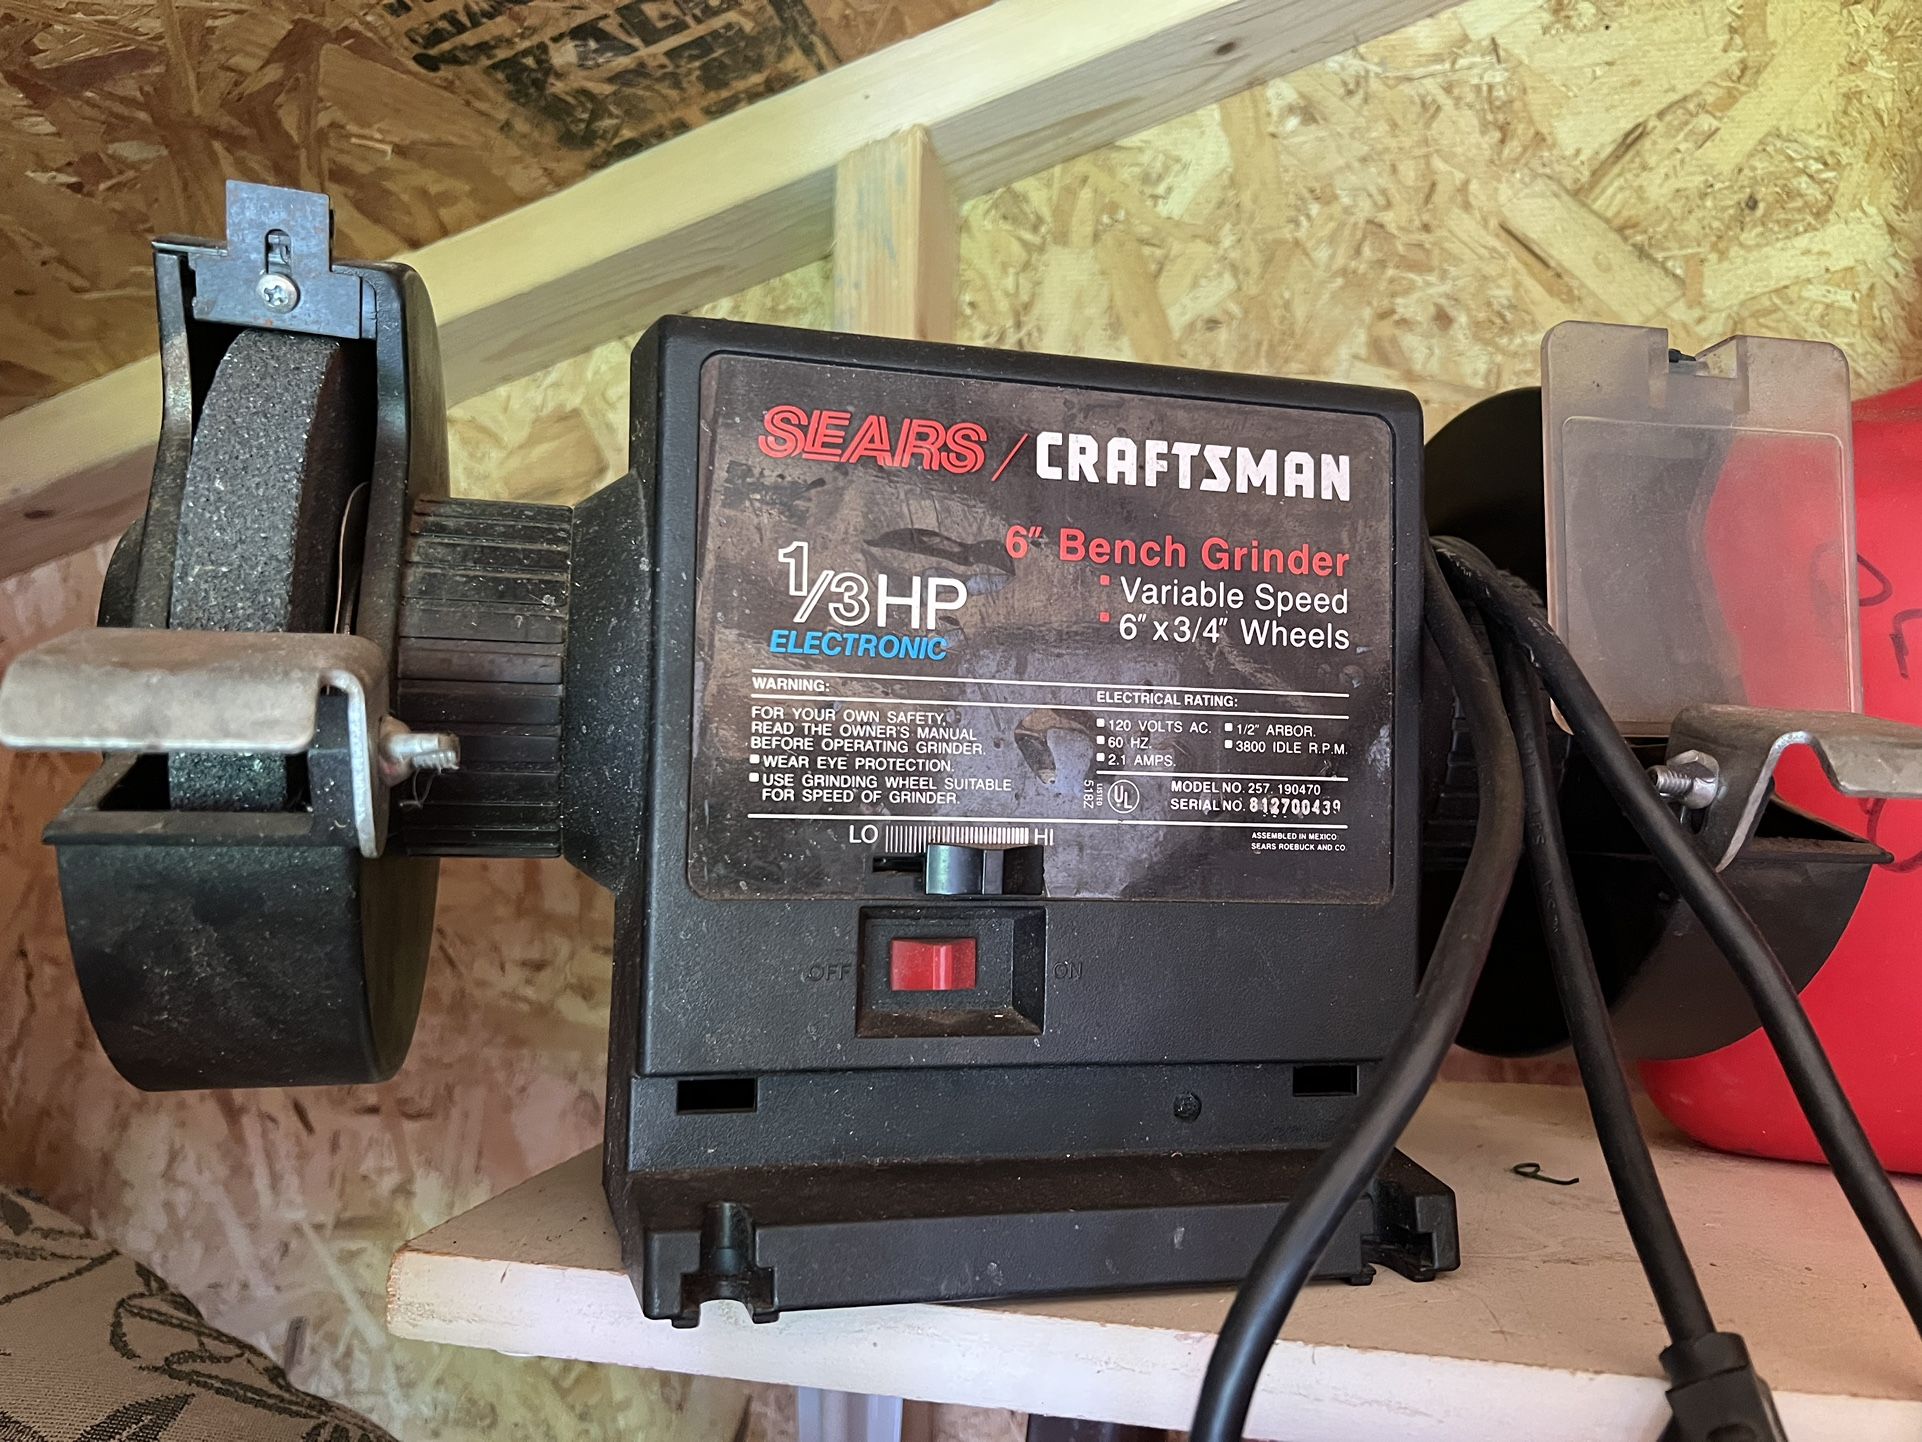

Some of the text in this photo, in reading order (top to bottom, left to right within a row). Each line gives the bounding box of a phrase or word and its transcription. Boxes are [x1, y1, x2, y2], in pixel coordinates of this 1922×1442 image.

[757, 405, 988, 476] SEARS
[1035, 431, 1351, 502] CRAFTSMAN
[1005, 524, 1350, 577] 6" Bench Grinder
[1120, 577, 1349, 615] Variable Speed
[1118, 613, 1146, 641] 6"
[1240, 619, 1351, 651] Wheels
[769, 629, 949, 662] ELECTRONIC
[752, 677, 830, 692] WARNING:
[1096, 691, 1238, 707] ELECTRICAL RATING:
[752, 706, 946, 725] FOR YOUR OWN SAFETY,
[751, 722, 977, 740] READ THE OWNER'S MANUAL
[1108, 720, 1212, 734] 120 VOLTS AC.
[1237, 724, 1316, 737] 1/2" ARBOR.
[751, 737, 986, 755] BEFORE OPERATING GRINDER.
[1108, 737, 1152, 749] 60 HZ.
[1236, 741, 1348, 756] 3800 IDLE R.P.M.
[763, 756, 955, 772] WEAR EYE PROTECTION.
[1108, 754, 1176, 767] 2.1 AMPS.
[762, 774, 1012, 791] USE GRINDING WHEEL SUITABLE
[1171, 781, 1219, 793] MODEL
[1222, 782, 1245, 793] NO.
[762, 789, 960, 805] FOR SPEED OF GRINDER.
[1170, 799, 1220, 811] SERIAL
[1222, 800, 1245, 811] NO.
[849, 824, 1054, 846] LO HI
[807, 962, 1082, 982] OFF ON
